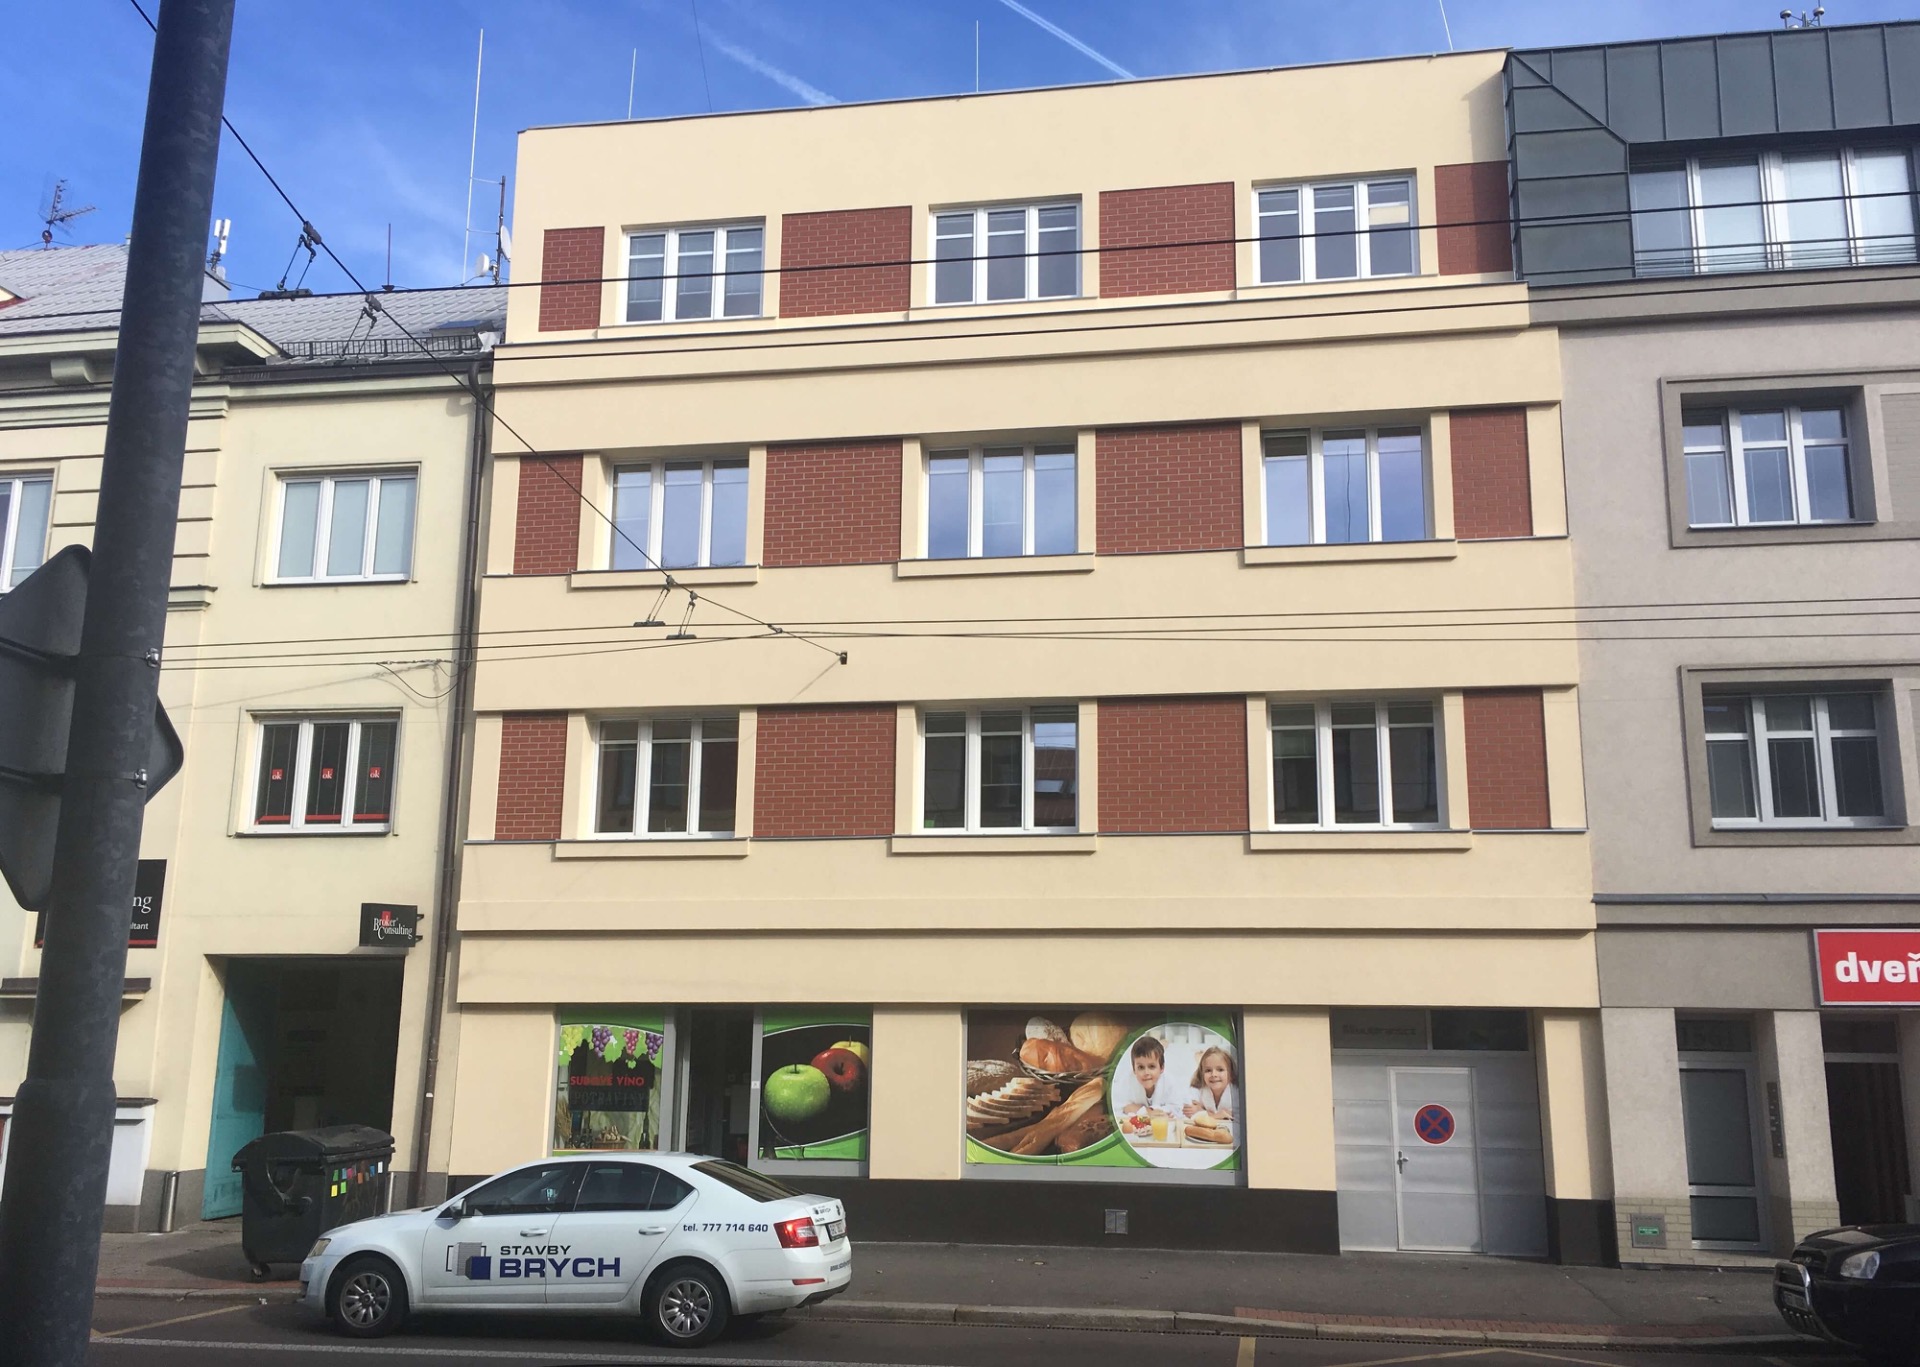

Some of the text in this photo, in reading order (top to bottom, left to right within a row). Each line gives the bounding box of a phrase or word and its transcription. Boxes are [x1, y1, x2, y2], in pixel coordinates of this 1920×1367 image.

[373, 915, 397, 931] Broker
[377, 924, 413, 940] Consulting
[616, 1074, 645, 1086] VÍNO
[683, 1223, 769, 1232] tel. 777 714 640
[500, 1245, 571, 1256] STAVBY
[499, 1257, 620, 1278] BRYCH
